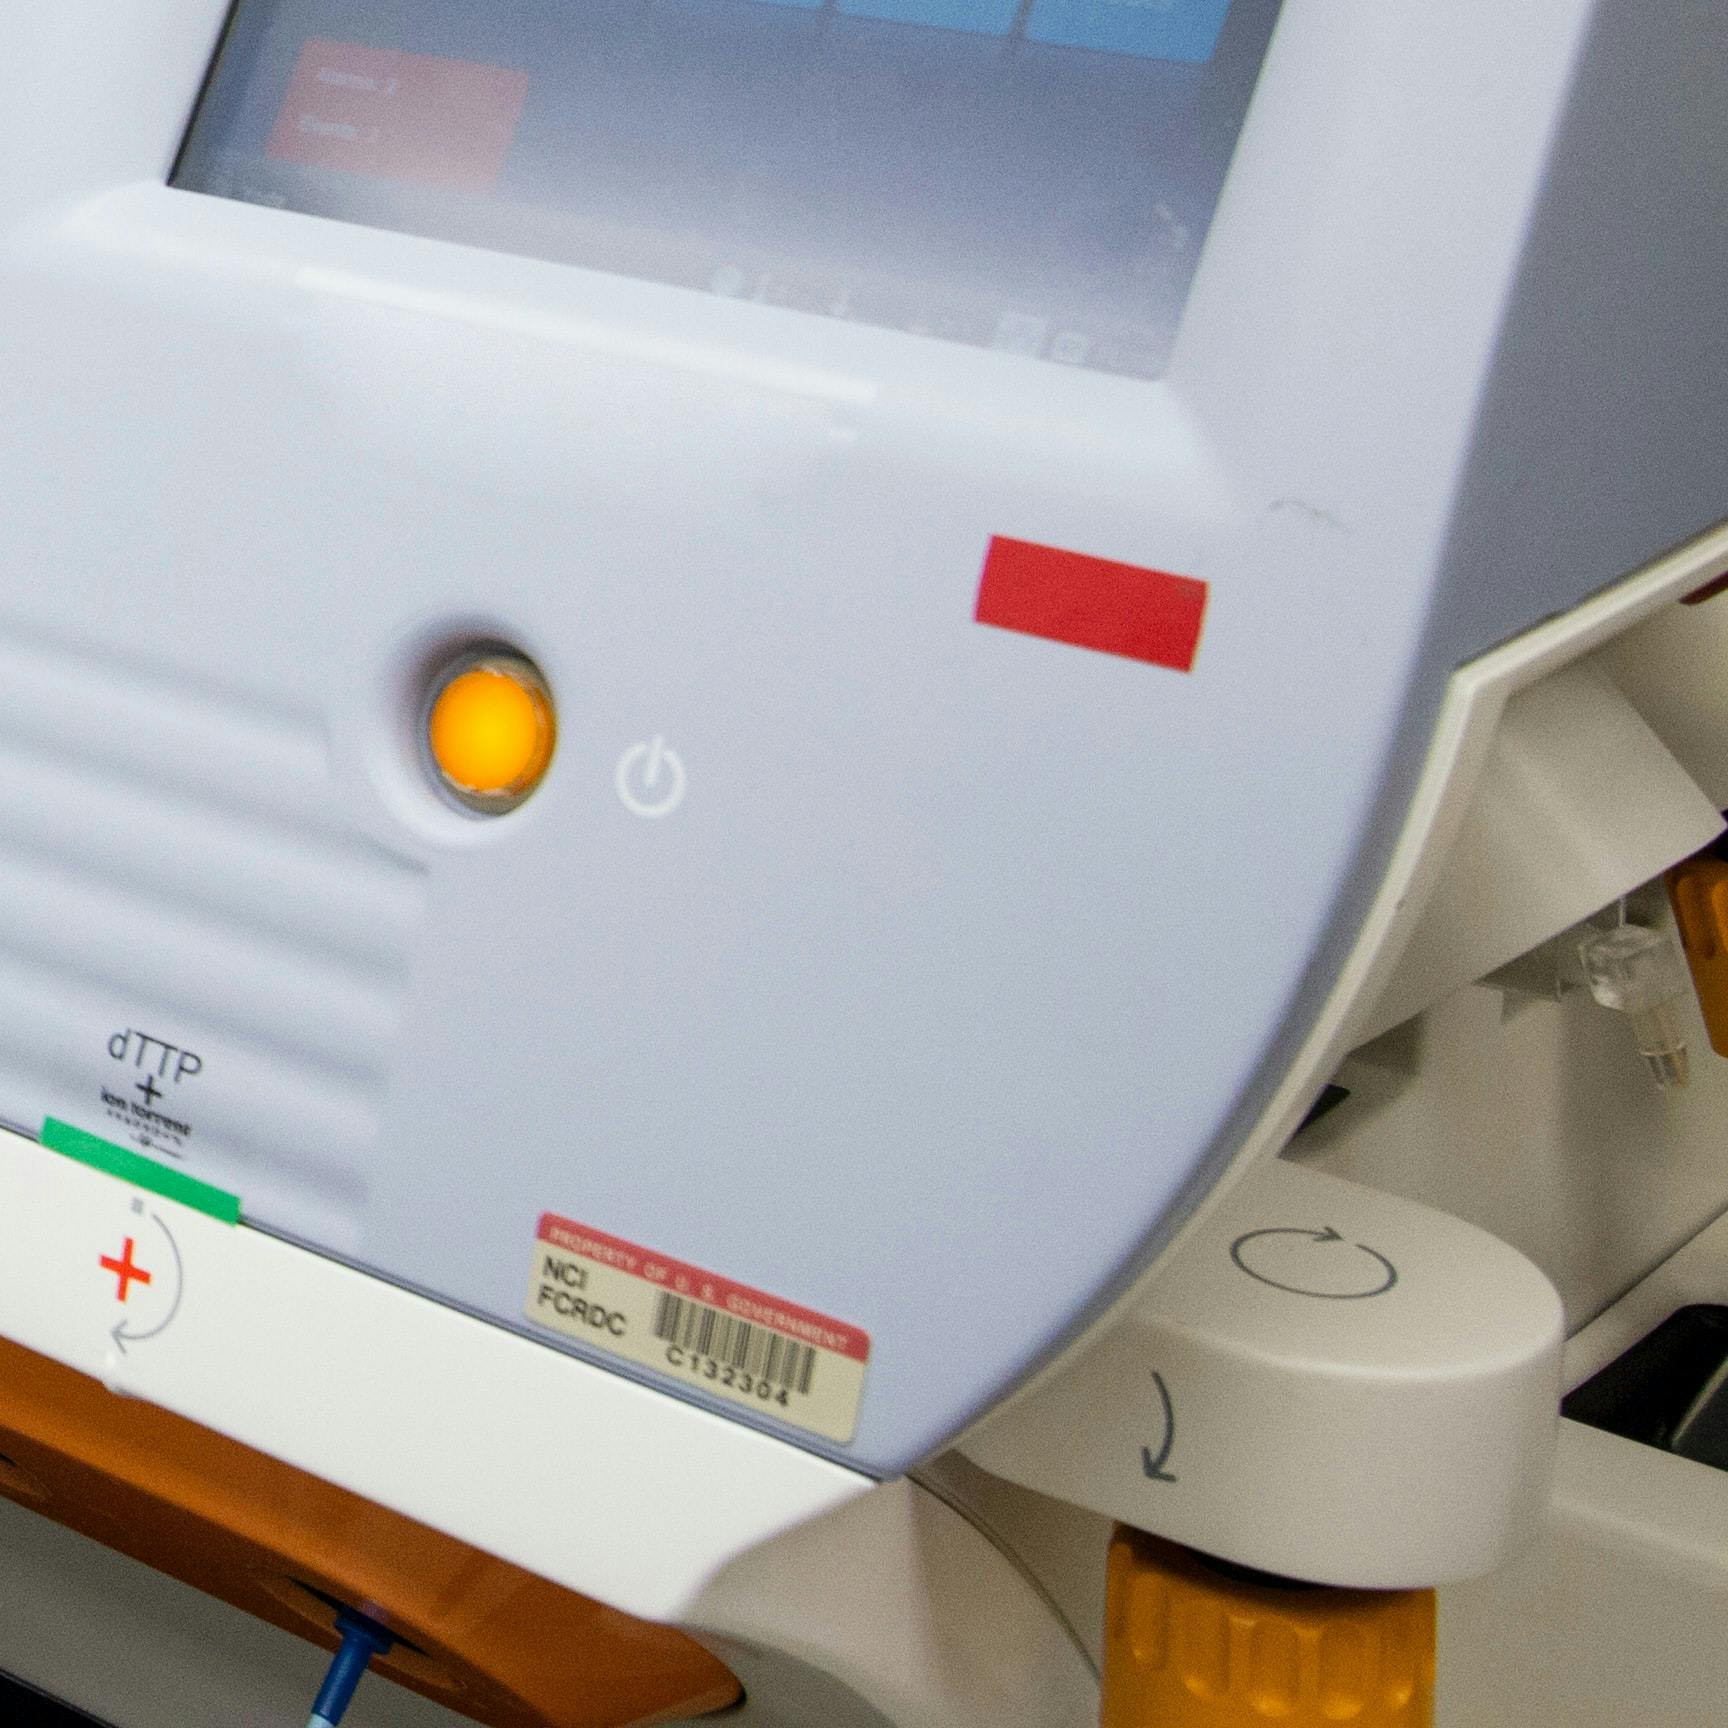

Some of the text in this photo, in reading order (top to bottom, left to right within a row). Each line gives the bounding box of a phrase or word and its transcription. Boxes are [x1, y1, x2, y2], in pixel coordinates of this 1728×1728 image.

[107, 1027, 203, 1084] dTTP
[542, 1255, 589, 1291] NCI
[548, 1225, 638, 1270] PROPERTY
[643, 1262, 669, 1283] OF
[726, 1291, 851, 1352] GOVERNMENT
[537, 1283, 628, 1338] FCRDC
[664, 1343, 791, 1408] C132304
